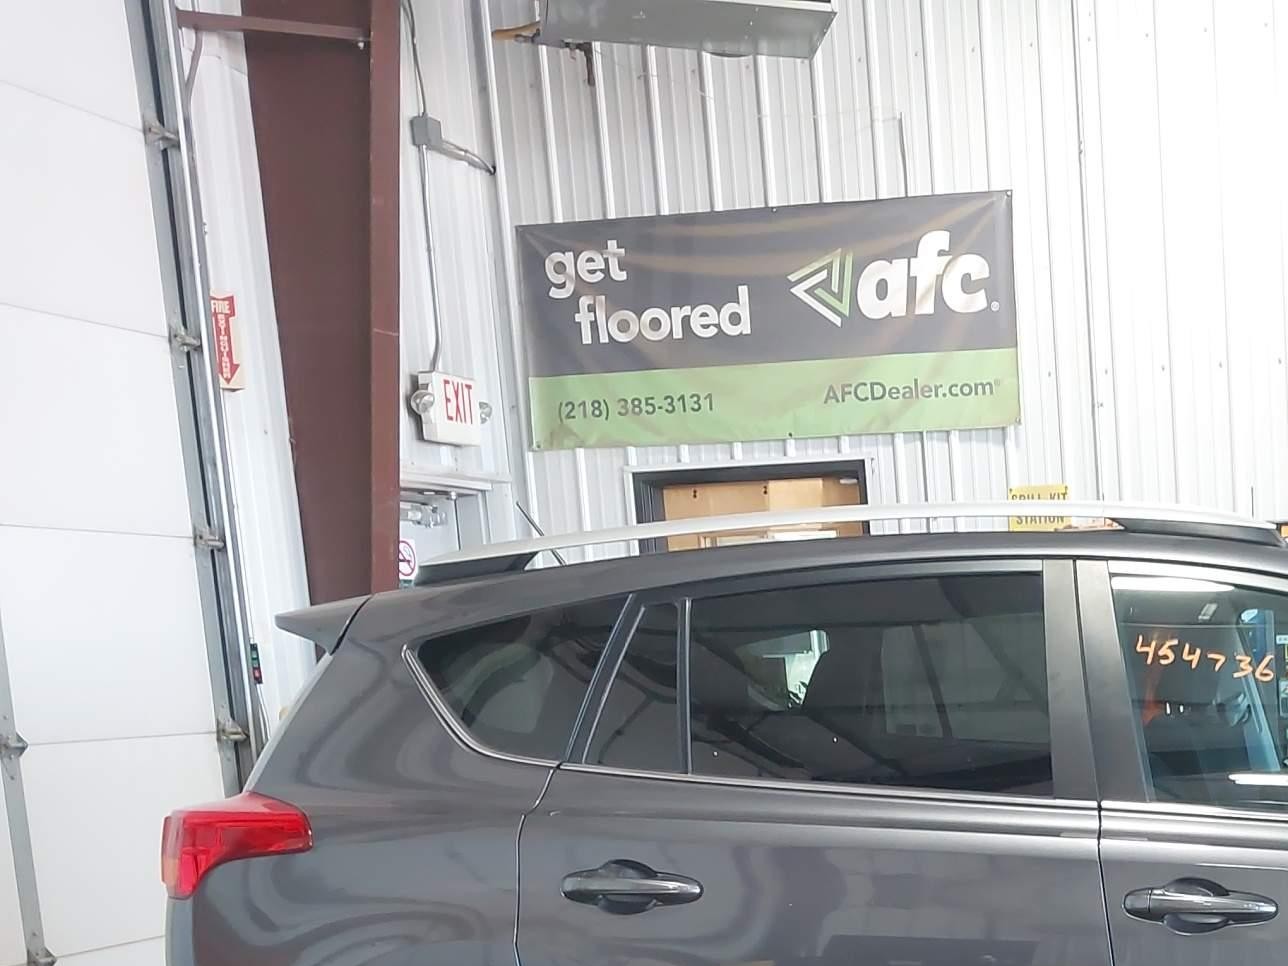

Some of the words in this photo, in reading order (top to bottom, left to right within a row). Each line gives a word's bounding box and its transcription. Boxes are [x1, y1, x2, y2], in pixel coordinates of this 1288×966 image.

[544, 240, 628, 298] get
[575, 285, 751, 345] floored
[443, 379, 473, 425] EXIT
[557, 399, 610, 421] (218)
[617, 392, 714, 417] 385-3131
